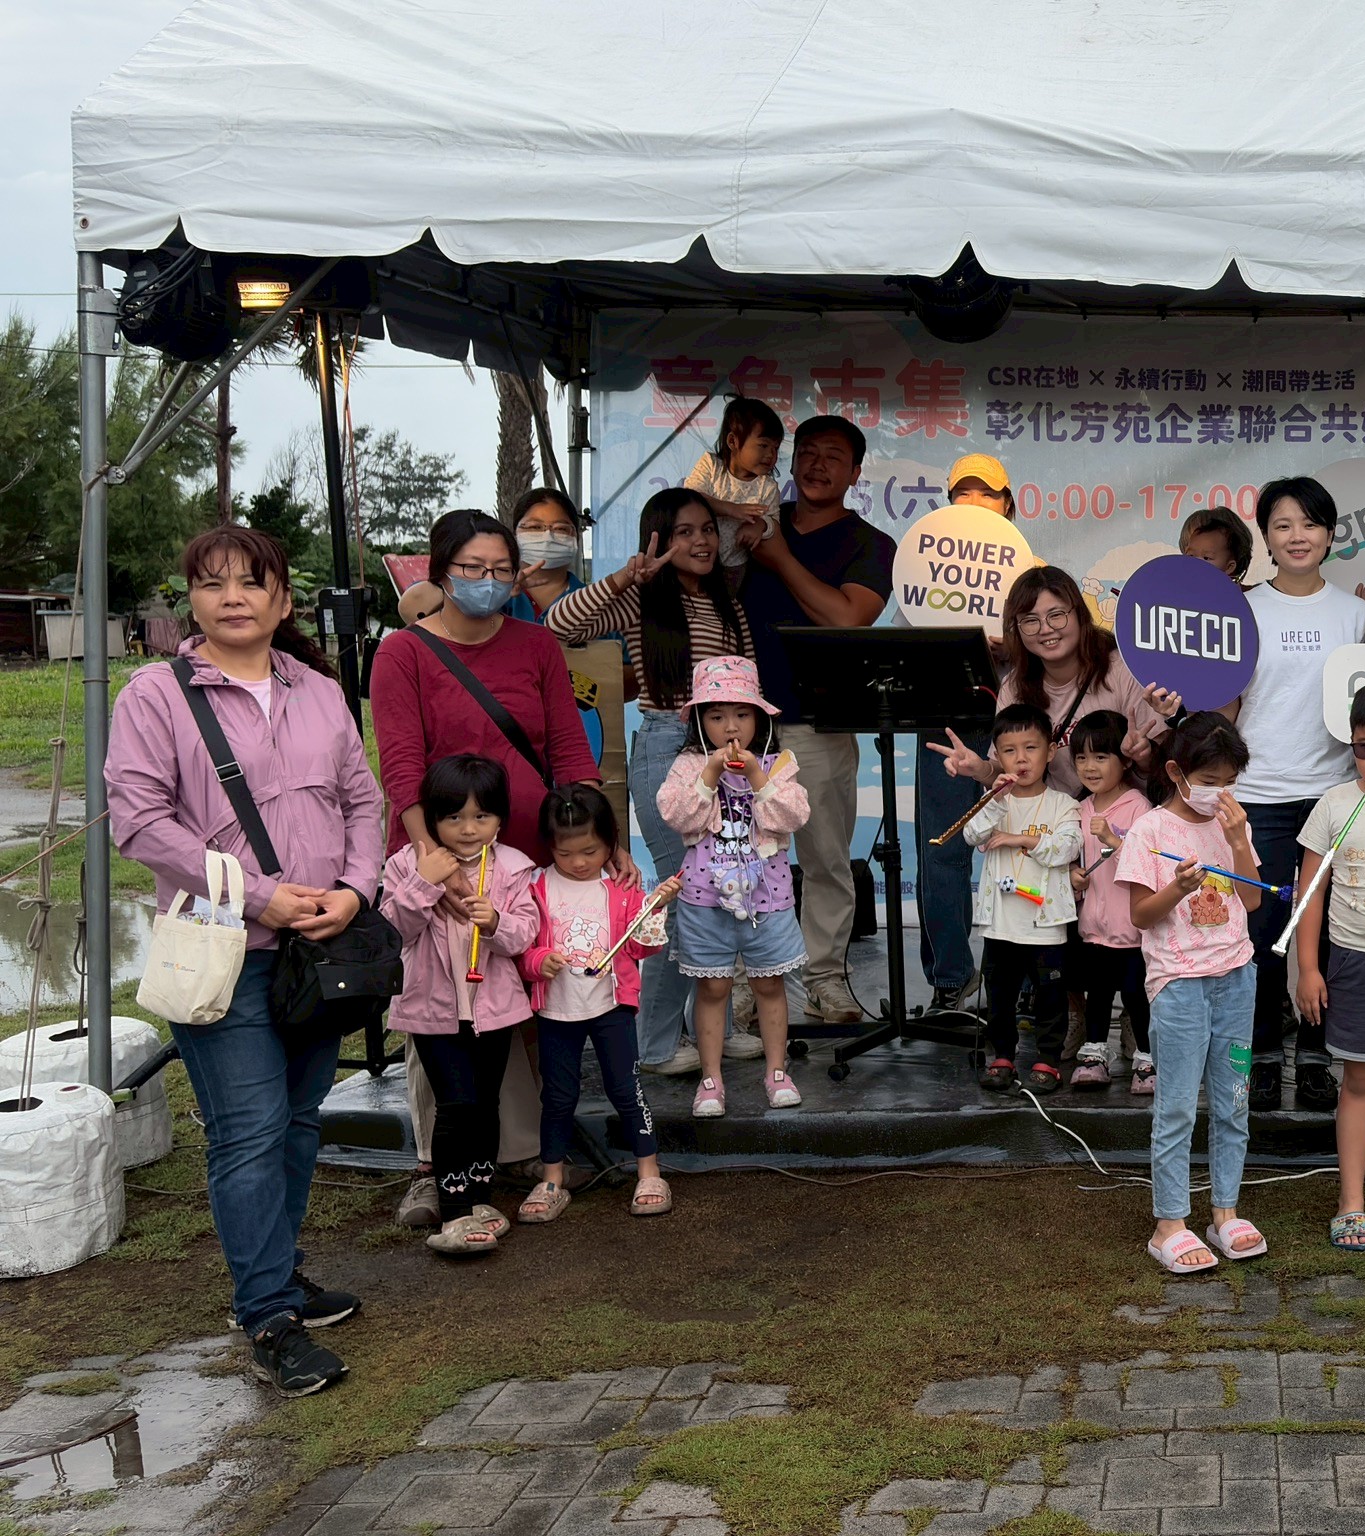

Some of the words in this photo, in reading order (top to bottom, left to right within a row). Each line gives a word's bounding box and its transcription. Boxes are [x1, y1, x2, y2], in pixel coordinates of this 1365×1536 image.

[987, 366, 1079, 388] CSR在地
[1114, 368, 1206, 392] 永續行動
[1241, 369, 1356, 393] 潮間帶生活
[1017, 483, 1261, 521] 0:00-17:00
[919, 533, 1016, 568] POWER
[928, 561, 1002, 592] YOUR
[903, 584, 1000, 618] WOORL
[1135, 602, 1241, 663] URECO
[1280, 630, 1321, 643] URECO
[1171, 1238, 1198, 1253] PUMA
